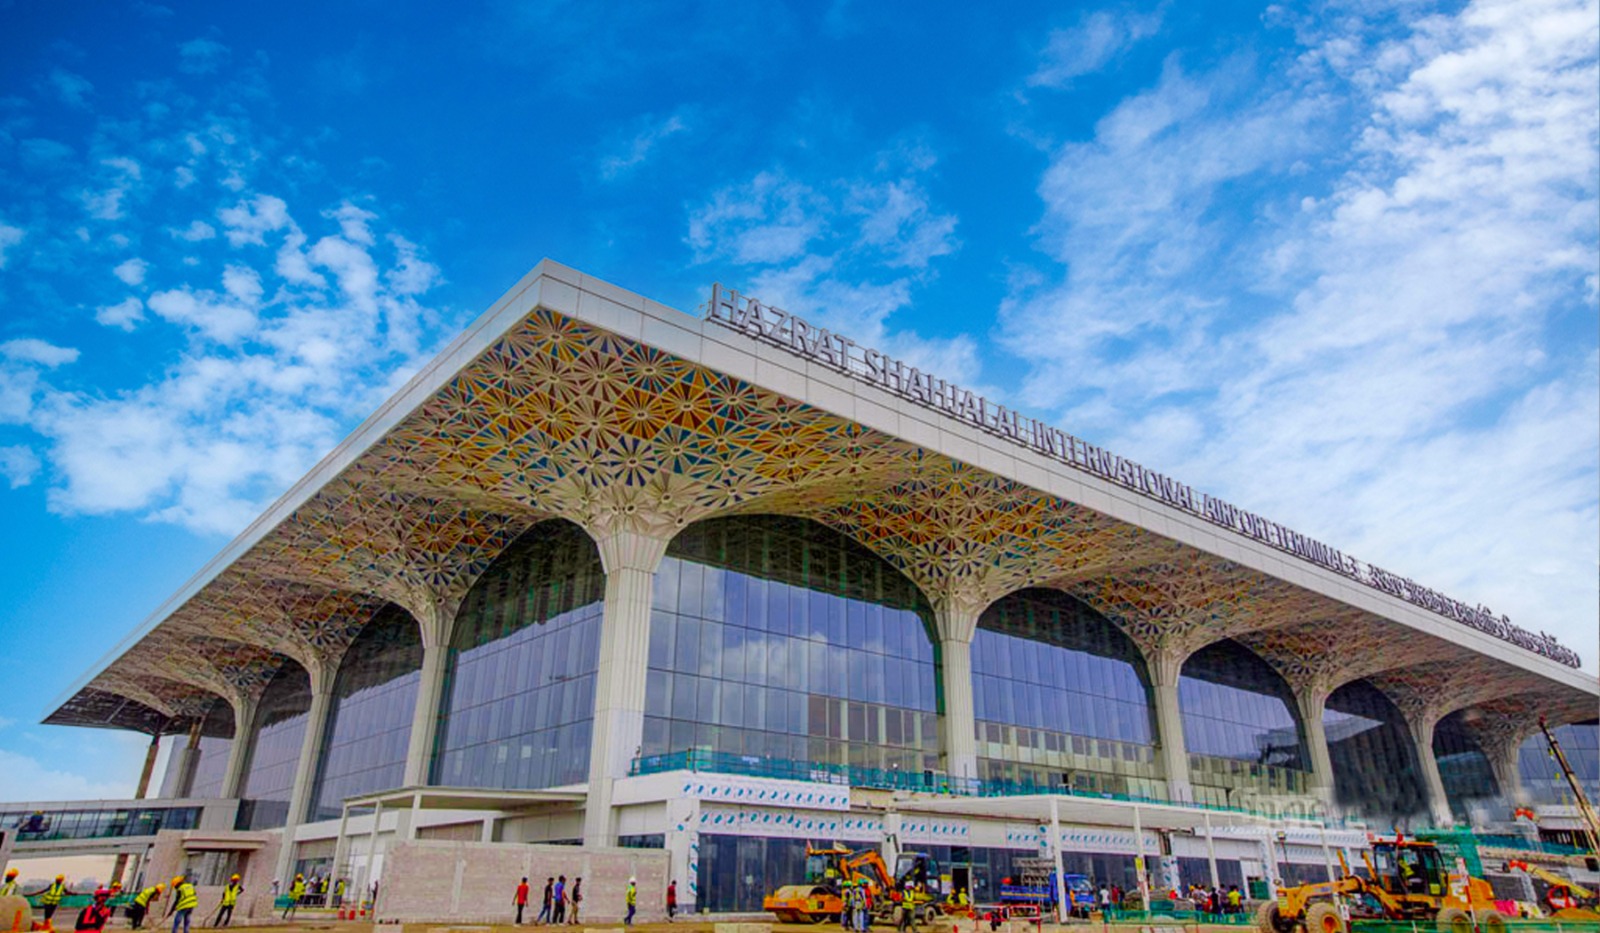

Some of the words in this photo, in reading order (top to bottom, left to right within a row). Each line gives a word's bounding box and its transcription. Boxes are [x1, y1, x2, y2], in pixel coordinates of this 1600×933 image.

[711, 282, 855, 370] HAZRAT
[864, 348, 1027, 444] SHAHJALAL
[1032, 419, 1199, 513] INTERNATIONAL
[1202, 493, 1271, 543] AIRPORT
